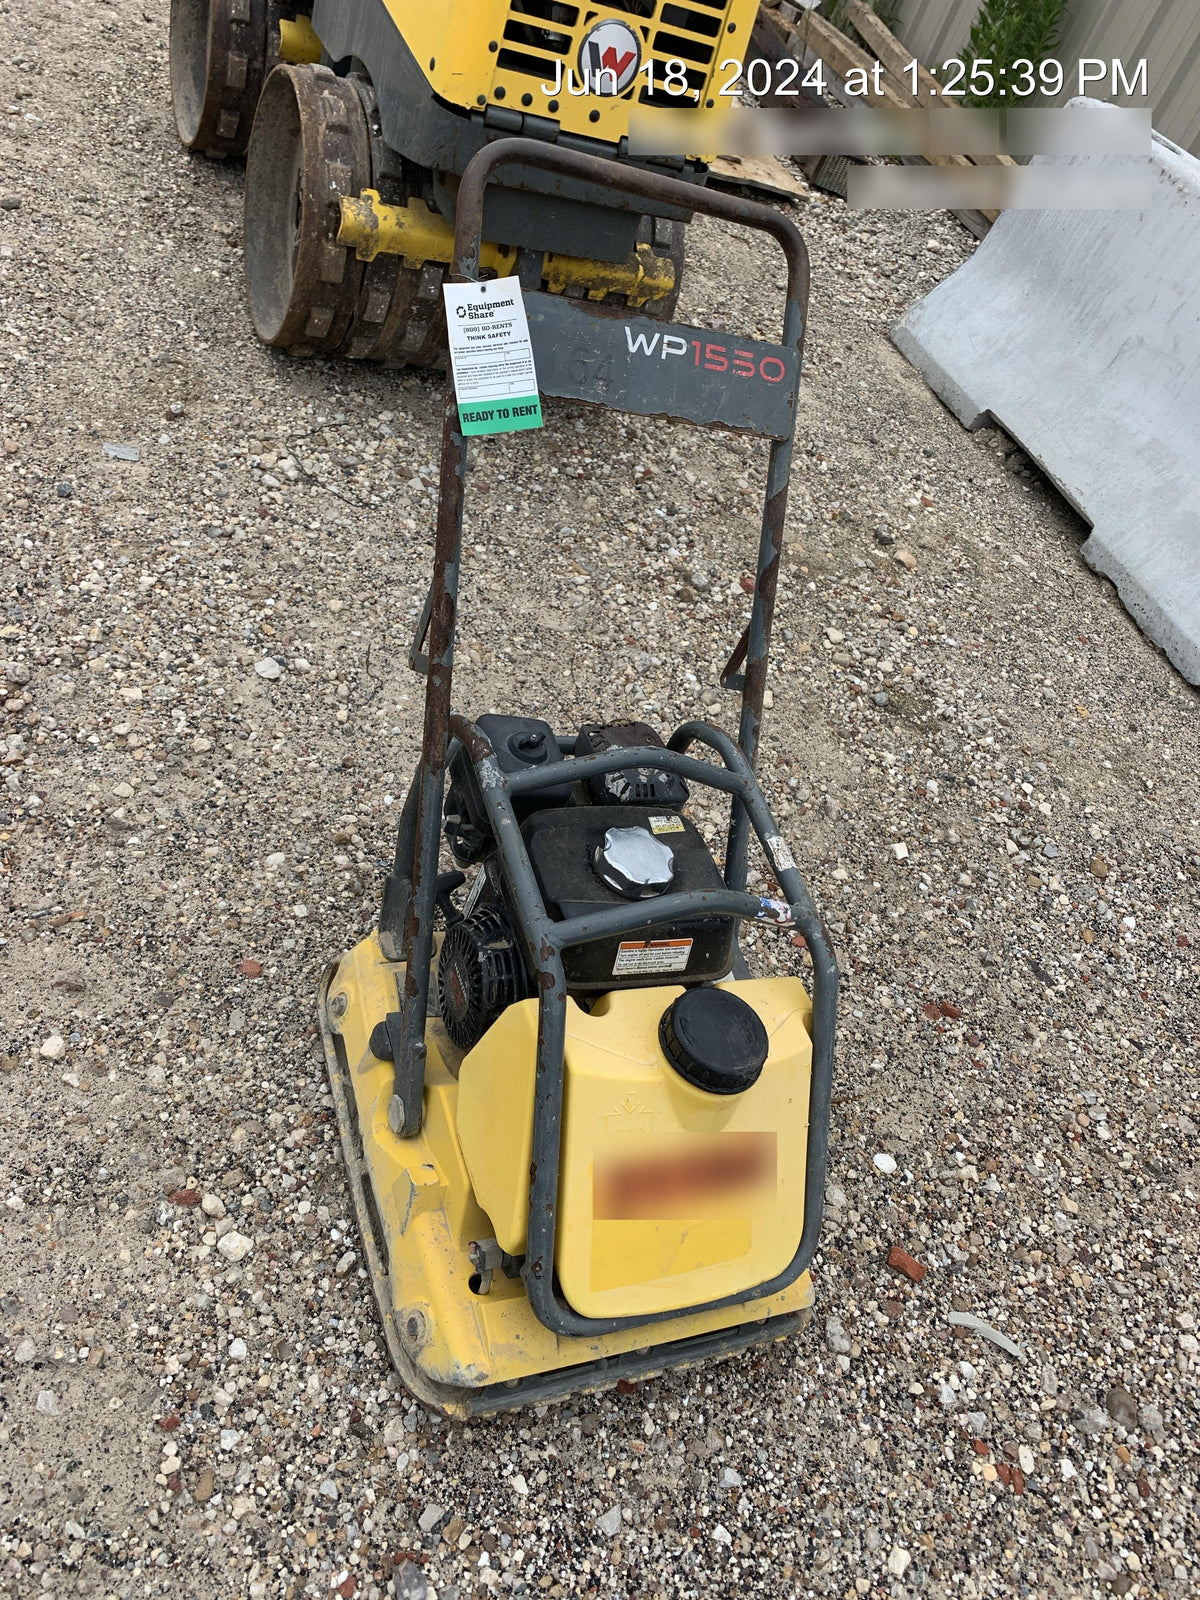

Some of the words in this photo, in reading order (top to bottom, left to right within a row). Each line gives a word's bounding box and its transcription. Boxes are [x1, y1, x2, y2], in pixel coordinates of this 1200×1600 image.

[467, 298, 514, 312] Equipment
[468, 311, 495, 320] Share
[487, 331, 511, 340] SAFETY
[624, 325, 786, 383] WP1550
[462, 409, 495, 423] READY
[497, 407, 510, 420] TO
[512, 404, 538, 418] RENT
